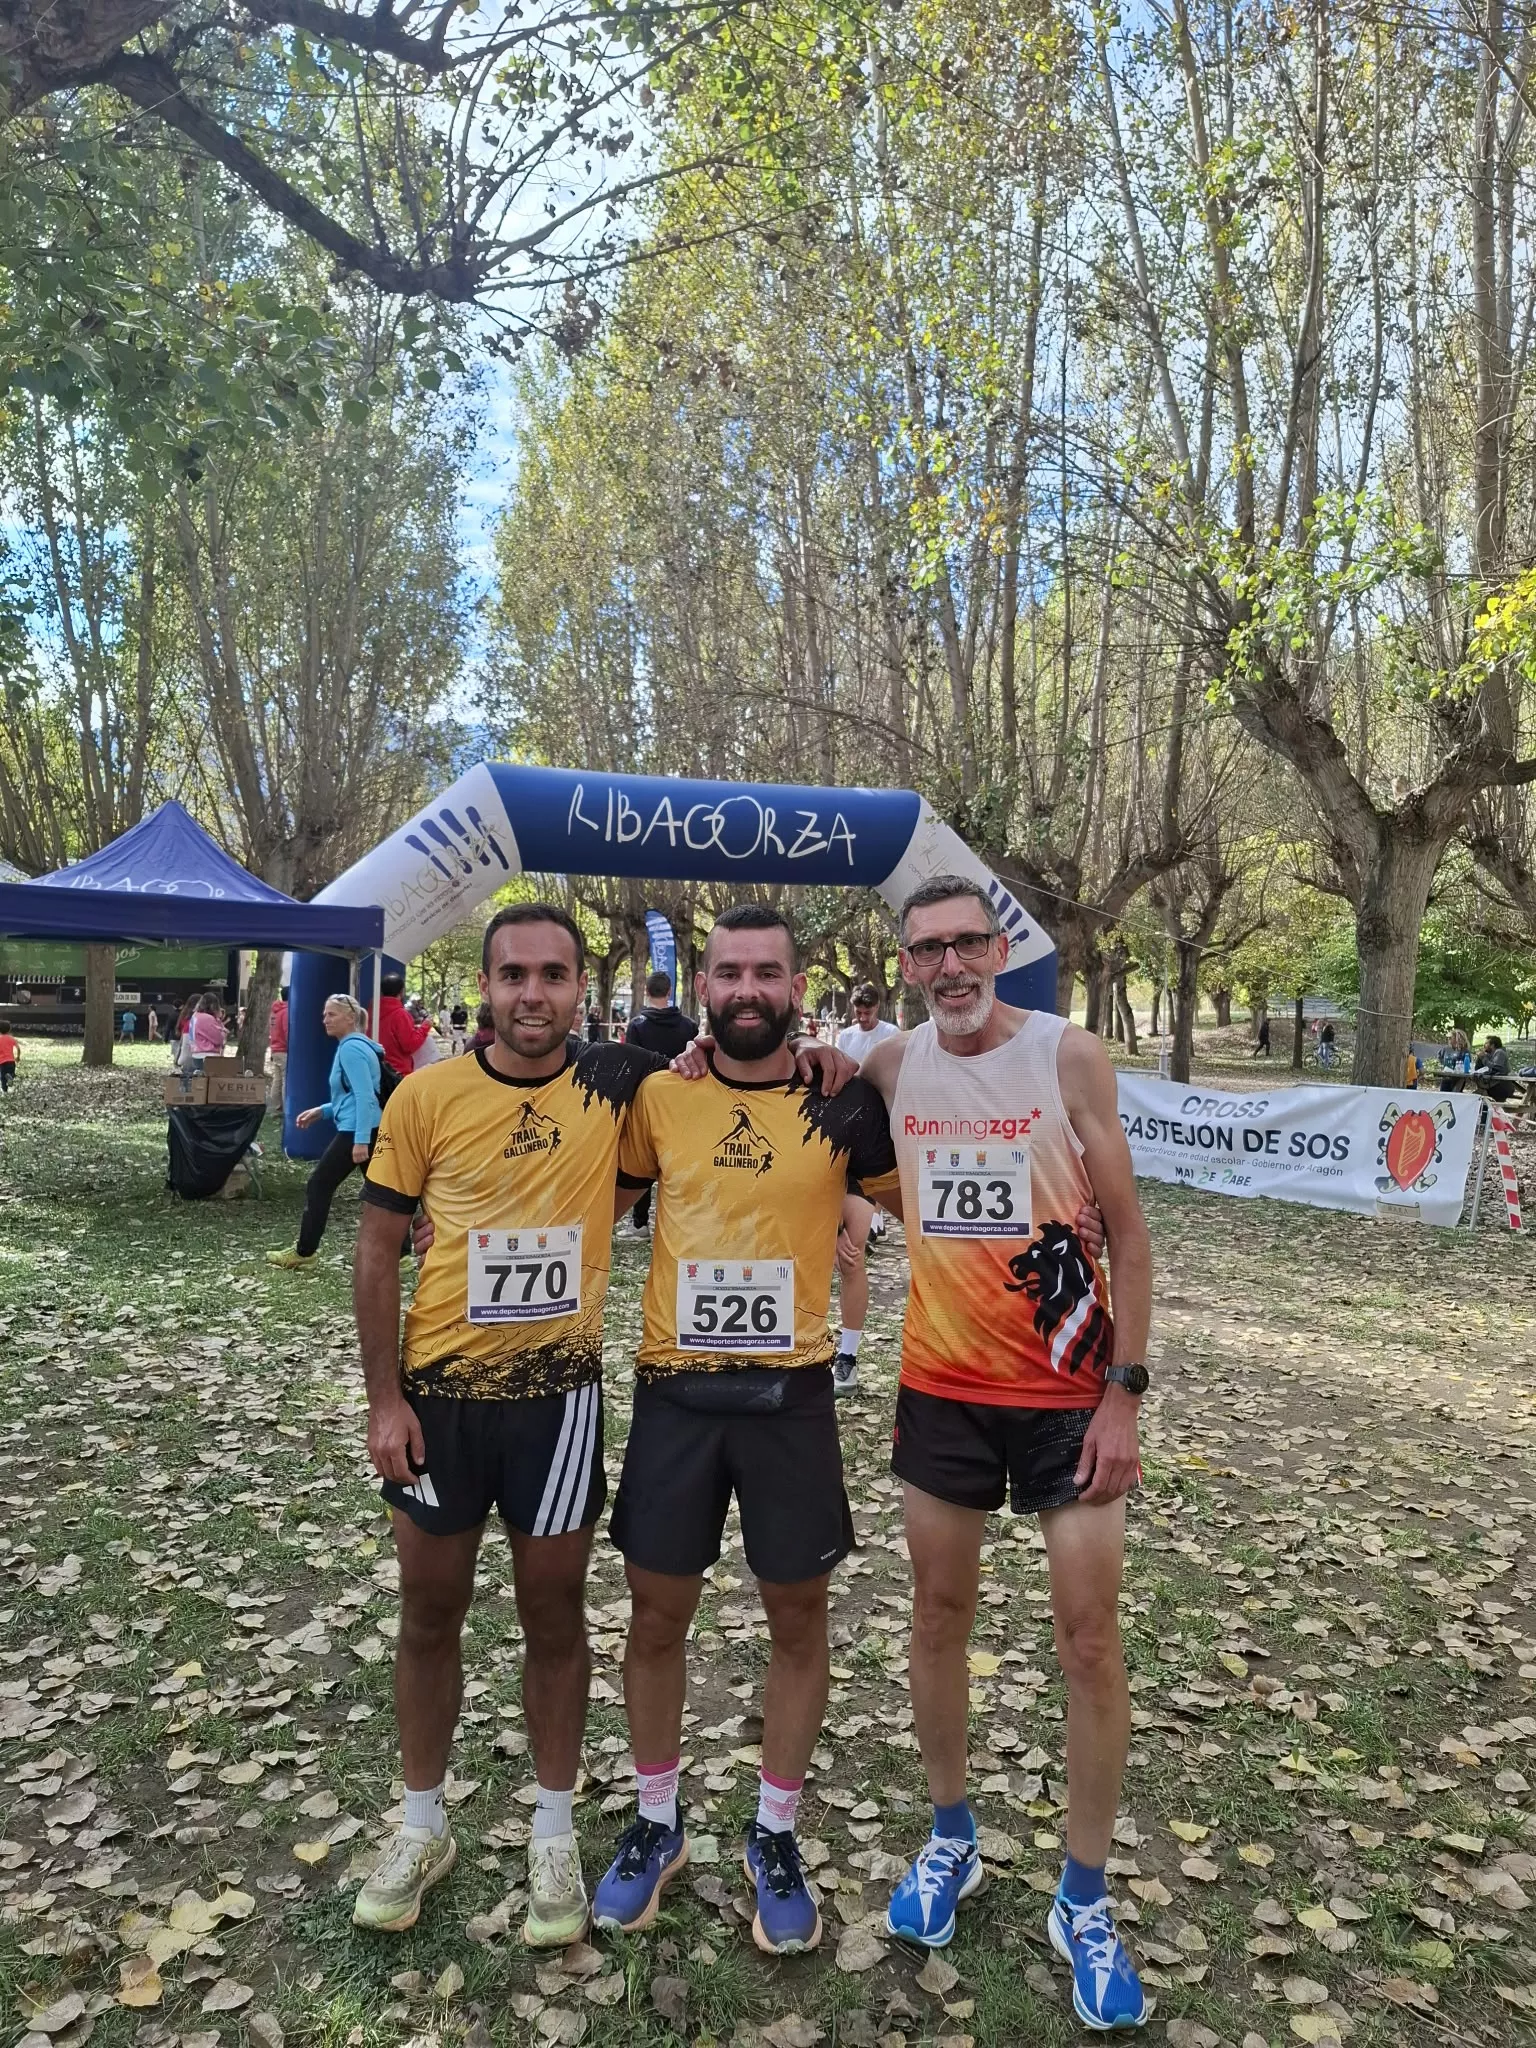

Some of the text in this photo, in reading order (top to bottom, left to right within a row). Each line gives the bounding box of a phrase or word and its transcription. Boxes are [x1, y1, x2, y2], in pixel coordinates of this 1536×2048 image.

[568, 783, 856, 866] RIBAGORZA
[1180, 1095, 1269, 1118] CROSS
[510, 1127, 541, 1144] TRAIL
[1243, 1129, 1281, 1154] DE
[1288, 1131, 1350, 1160] SOS
[503, 1138, 549, 1159] GALLINERO
[723, 1142, 752, 1157] TRAIL
[713, 1156, 759, 1169] GALLINERO
[1136, 1143, 1176, 1157] deportivos
[1189, 1153, 1209, 1163] edad
[1210, 1156, 1245, 1166] escolar
[1252, 1158, 1291, 1171] Gobierno
[1293, 1164, 1305, 1172] de
[1306, 1164, 1343, 1177] Aragón
[931, 1180, 1014, 1220] 783
[930, 1224, 1019, 1233] www.deportesribagorza.com
[484, 1260, 568, 1302] 770
[480, 1302, 570, 1315] www.deportesribagorza.com
[692, 1294, 778, 1333] 526
[689, 1337, 781, 1345] www.deportesribagorza.com
